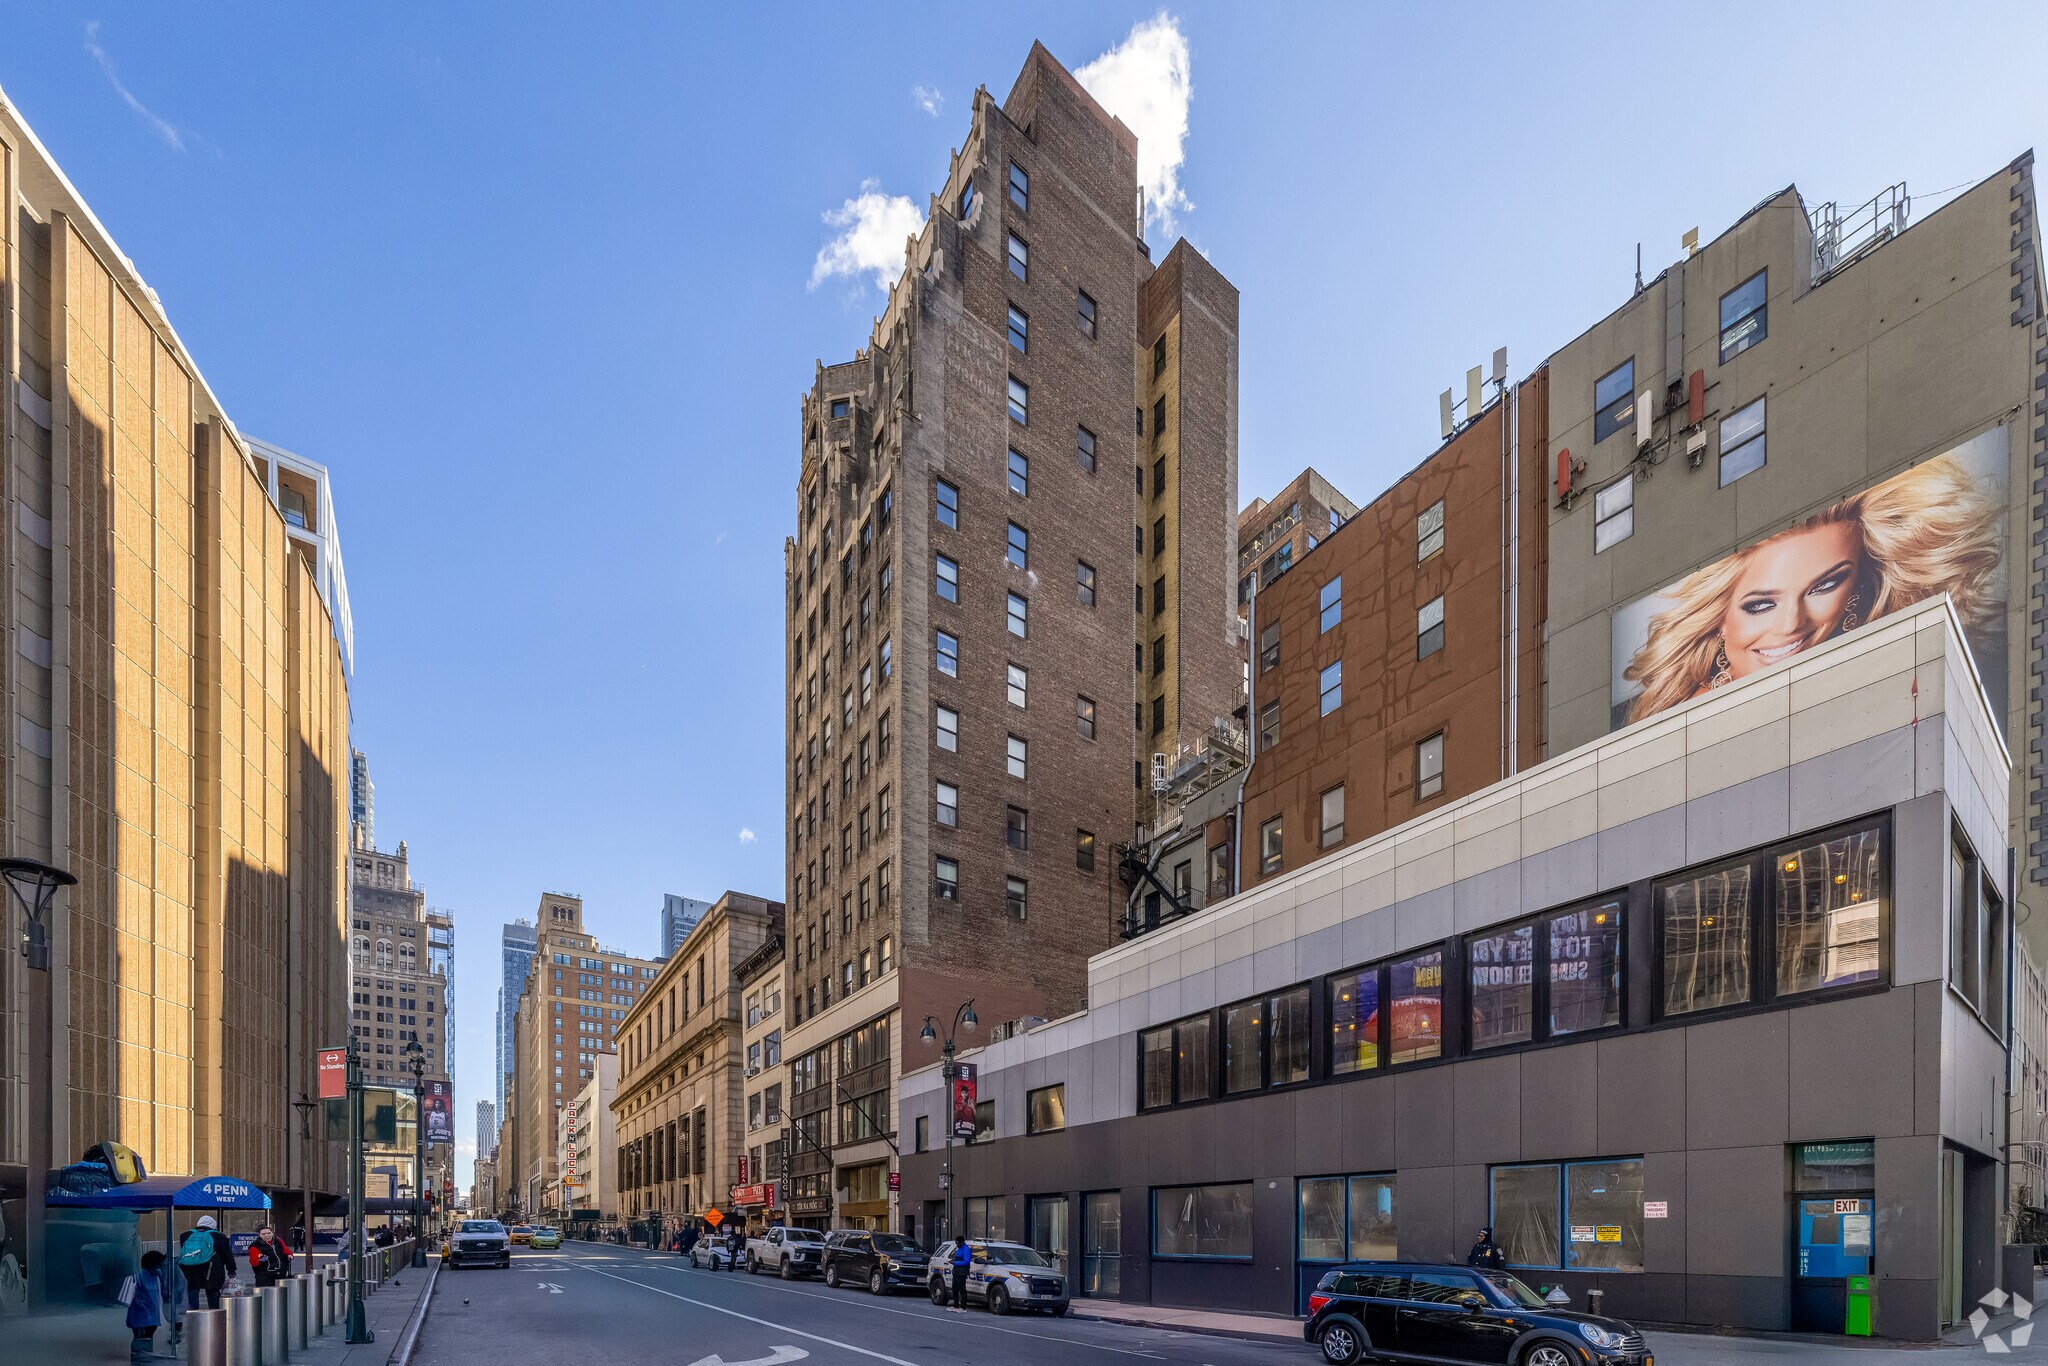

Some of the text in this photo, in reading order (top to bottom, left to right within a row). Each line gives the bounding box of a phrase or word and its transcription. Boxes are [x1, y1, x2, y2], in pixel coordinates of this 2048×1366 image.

[202, 1183, 248, 1196] 4 PENN
[1835, 1200, 1857, 1212] EXIT
